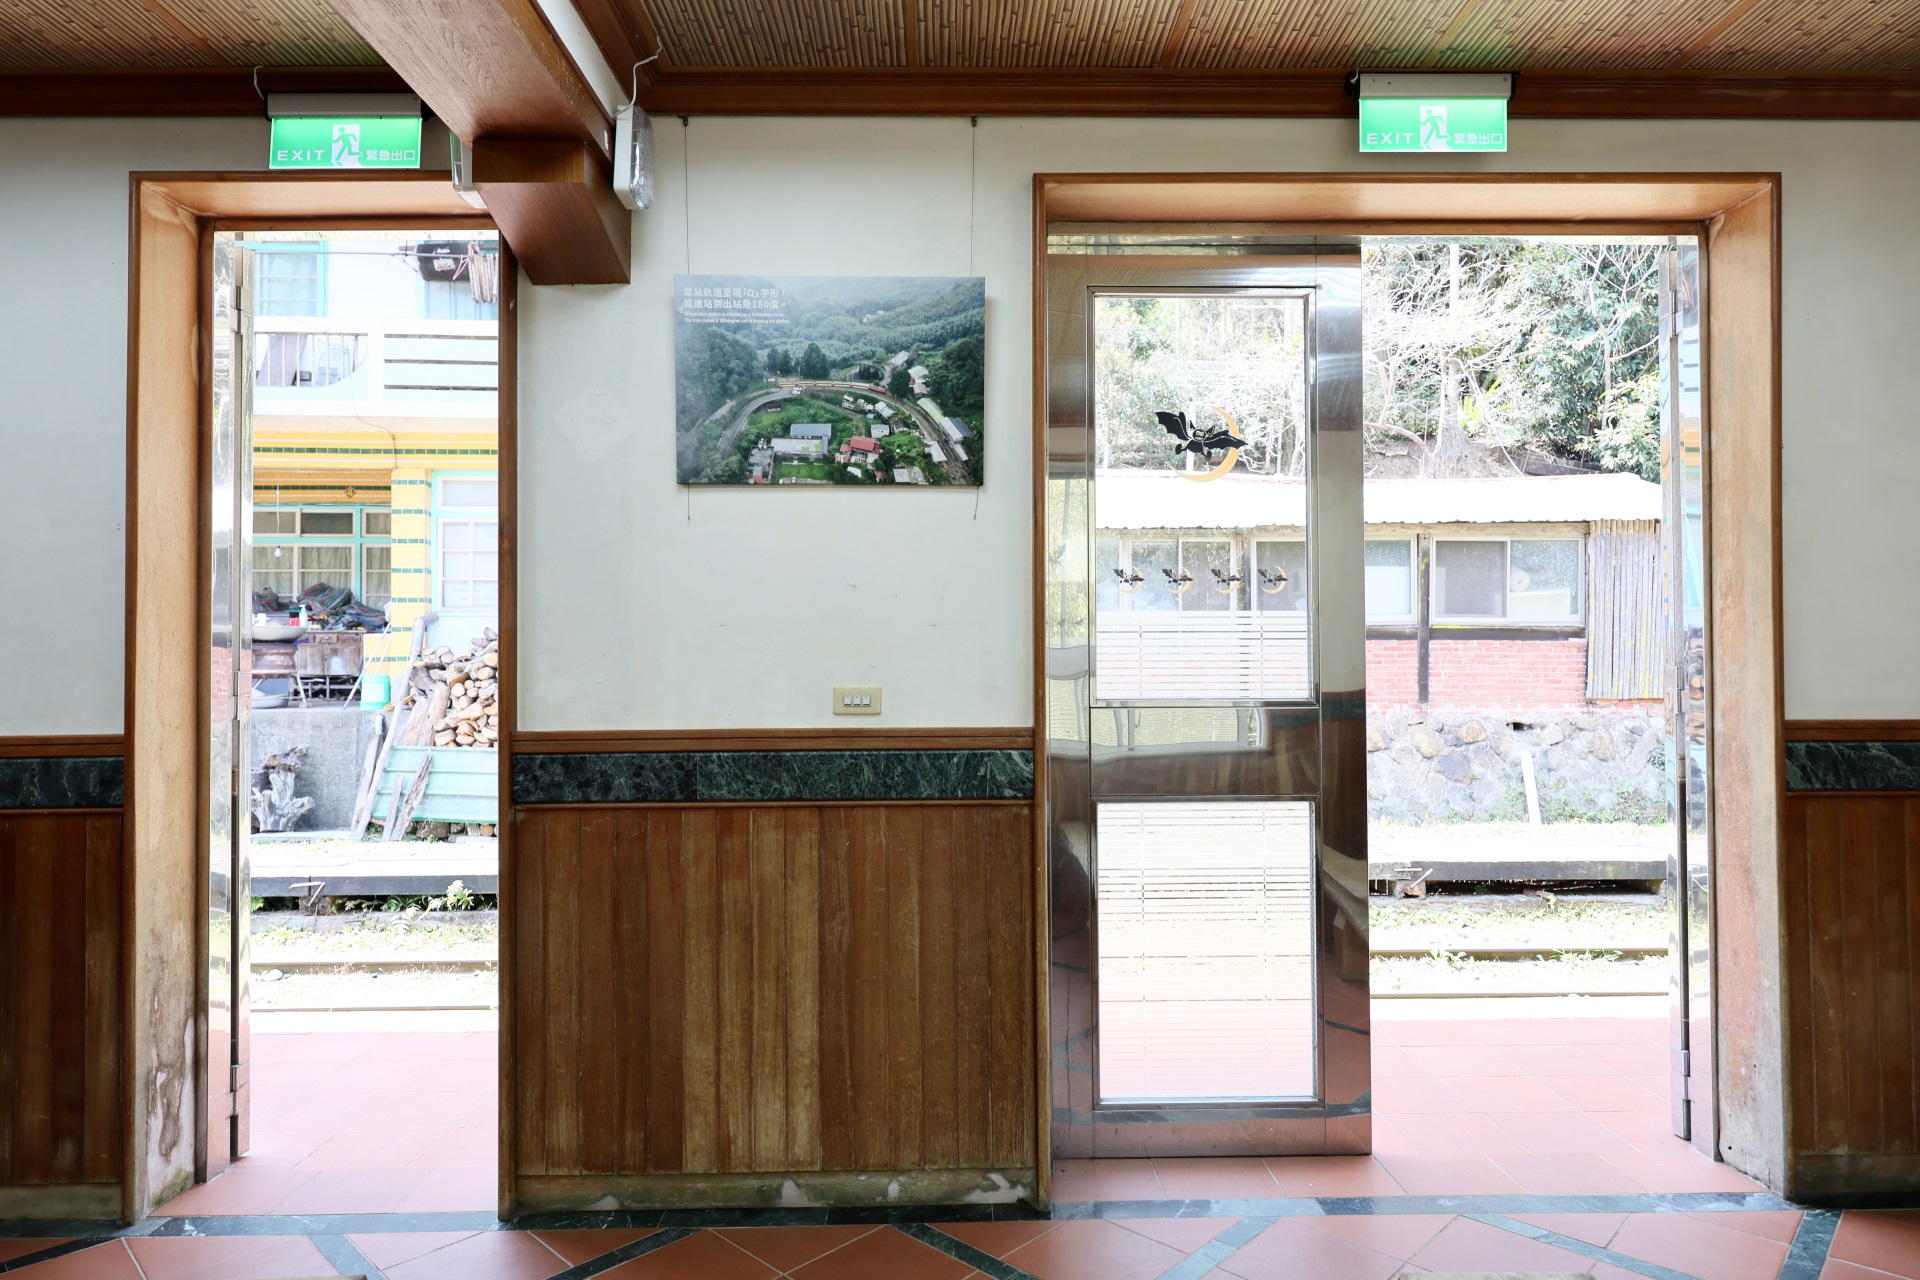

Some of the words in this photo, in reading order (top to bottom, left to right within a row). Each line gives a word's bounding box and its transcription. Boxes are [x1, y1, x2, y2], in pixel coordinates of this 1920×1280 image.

[1366, 132, 1414, 145] EXIT
[1454, 132, 1503, 145] 緊急出口
[277, 149, 326, 161] EXIT
[366, 149, 416, 161] 緊急出口
